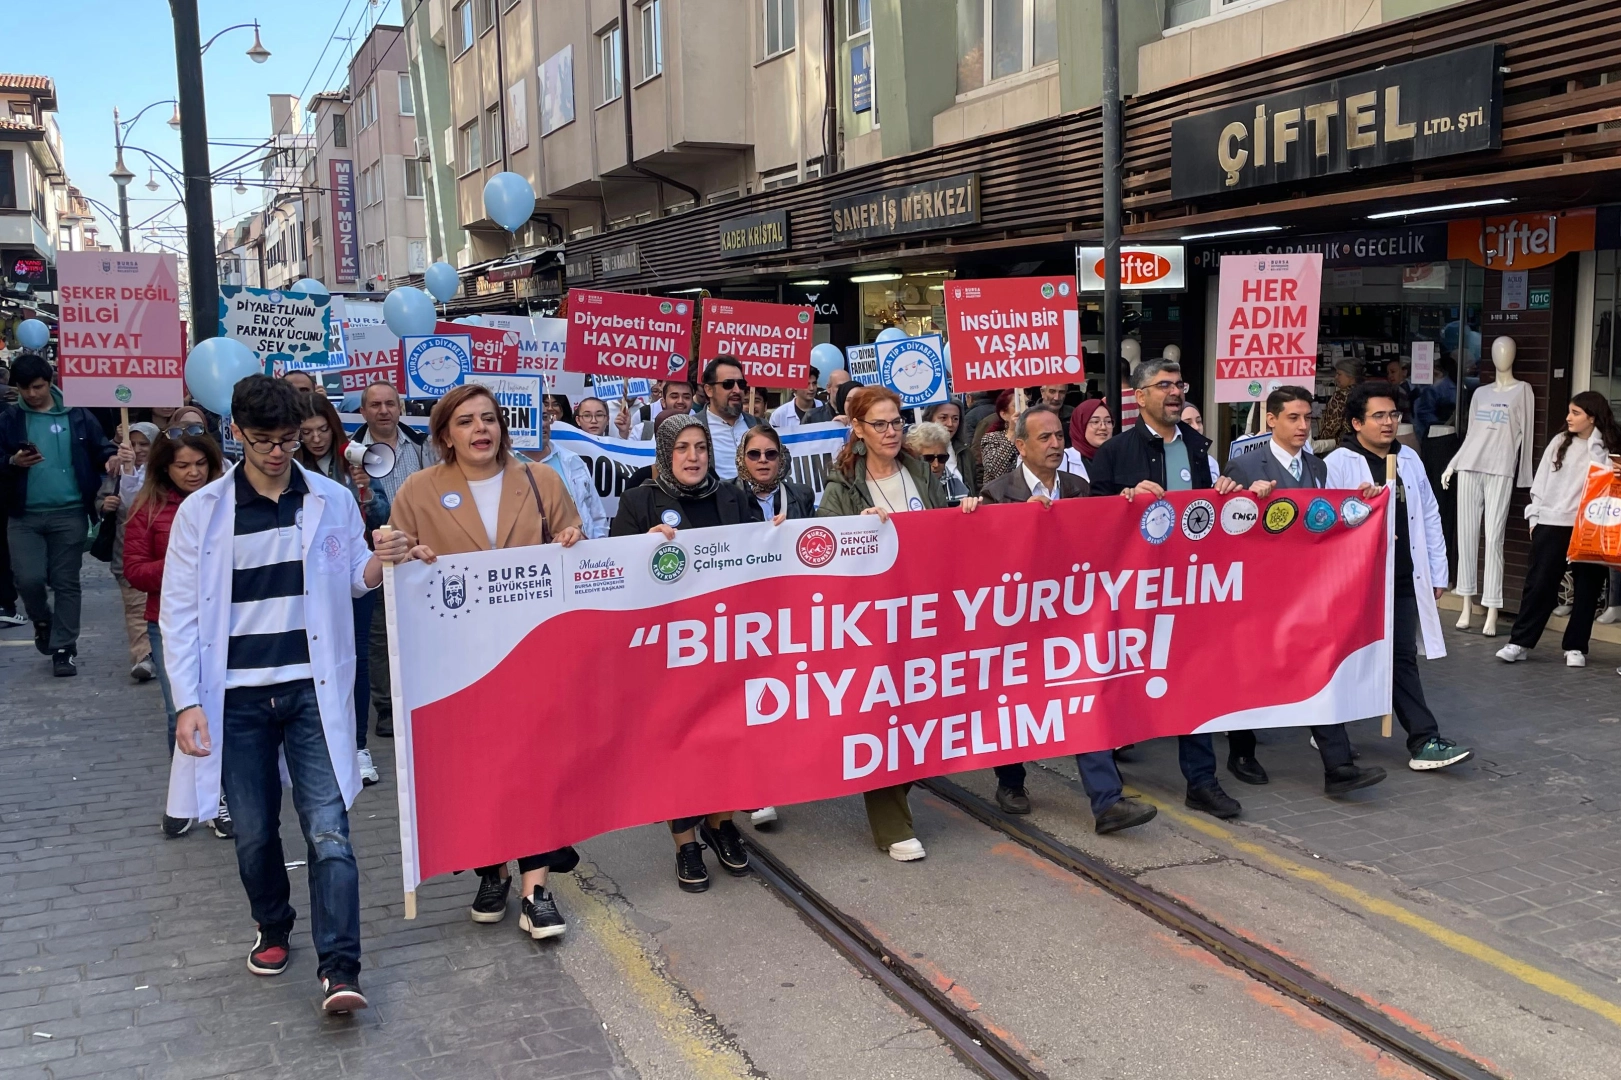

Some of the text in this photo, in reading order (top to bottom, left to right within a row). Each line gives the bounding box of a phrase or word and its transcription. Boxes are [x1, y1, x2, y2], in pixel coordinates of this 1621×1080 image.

[1218, 85, 1483, 186] ÇİFTEL LTD. ŞTİ
[335, 162, 351, 208] MERT
[833, 179, 972, 232] SANER İŞ MERKEZİ
[721, 222, 783, 251] KADER KRİSTAL
[1355, 232, 1425, 258] GECELİK
[1479, 215, 1557, 267] Çiftel
[61, 284, 176, 304] ŞEKER DEĞİL,
[1242, 278, 1298, 303] HER
[1531, 294, 1550, 303] 101C
[62, 303, 119, 323] BİLGİ
[237, 299, 316, 317] DİYABETLİNİN
[1229, 305, 1308, 330] ADIM
[253, 314, 296, 328] EN ÇOK
[574, 311, 686, 336] Diyabeti tanı,
[960, 307, 1058, 331] İNSÜLİN BİR
[236, 325, 323, 341] PARMAK UCUNU
[707, 321, 808, 340] FARKINDA OL!
[64, 332, 143, 350] HAYAT
[257, 339, 285, 353] SEV
[583, 331, 675, 353] HAYATINI
[718, 337, 796, 359] DİYABETİ
[974, 331, 1050, 359] YAŞAM
[1229, 332, 1305, 357] FARK
[65, 357, 178, 375] KURTARIR
[410, 352, 420, 376] BURSA
[416, 342, 428, 353] TİP
[597, 351, 658, 370] KORU!
[702, 358, 808, 379] KTROL ET
[884, 361, 893, 385] BURSA
[889, 348, 899, 359] TİP
[906, 342, 942, 378] DİYABETLİLER
[1220, 359, 1312, 378] YARATIR
[597, 381, 647, 398] DAHA TALIDIR
[807, 530, 827, 540] BURSA
[840, 535, 879, 545] GENÇLİK
[658, 546, 680, 556] BURSA
[694, 543, 730, 556] Sağlık
[801, 547, 812, 561] KENT
[840, 544, 879, 557] MECLİSİ
[579, 557, 616, 570] Mustafa
[653, 560, 685, 580] KENT KONSEYİ
[693, 552, 782, 573] Çalışma Grubu
[488, 563, 552, 583] BURSA
[574, 567, 624, 582] BOZBEY
[488, 577, 552, 594] BÜYÜKŞEHİR
[575, 584, 625, 595] BELEDİYE BAŞKANI
[593, 579, 625, 588] BÜYÜKŞEHİR
[953, 553, 1244, 632] YÜRÜYELİM
[489, 589, 553, 605] BELEDİYESİ
[745, 613, 1174, 726] DİYABETE DUR!
